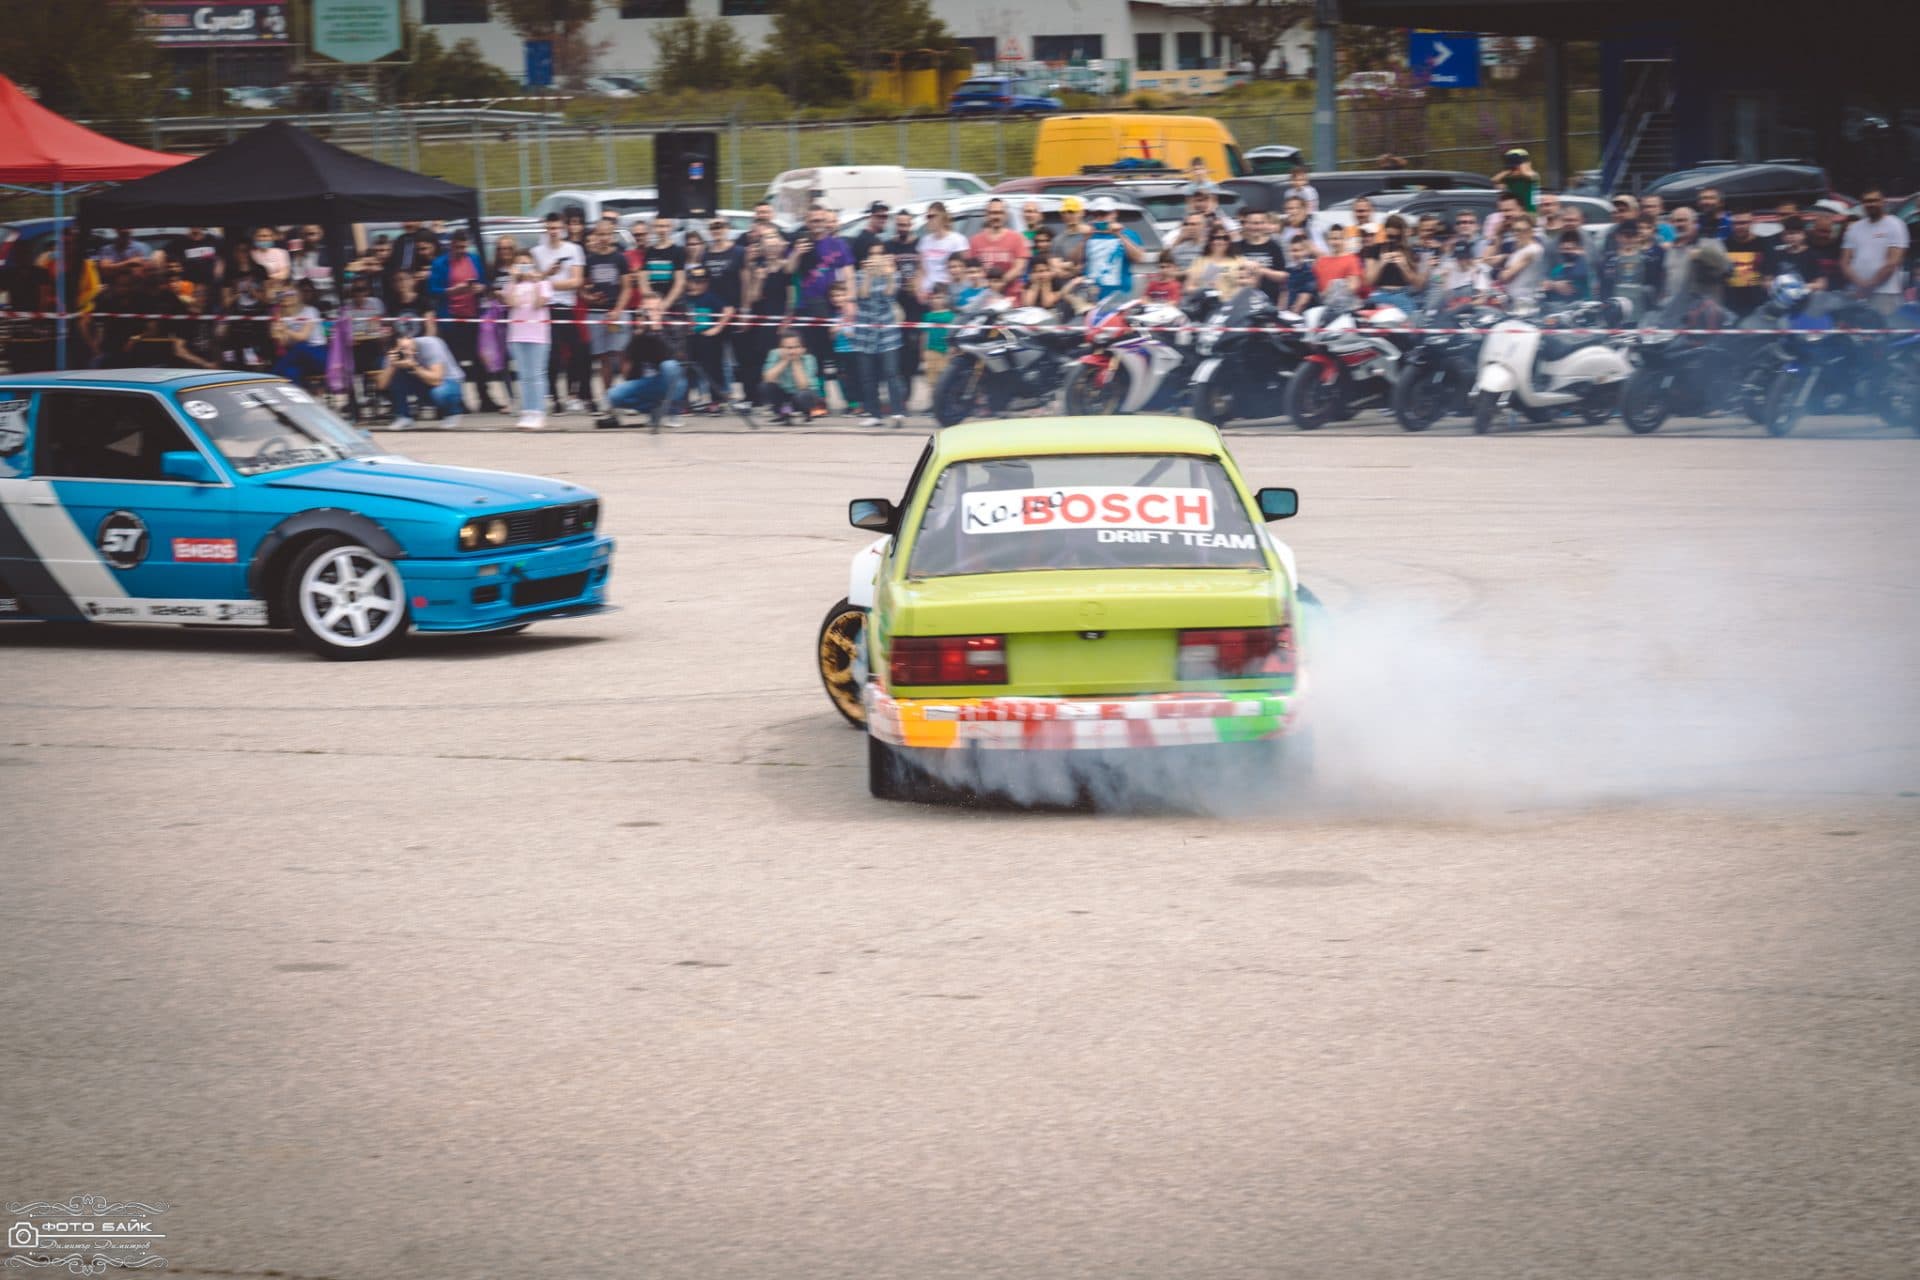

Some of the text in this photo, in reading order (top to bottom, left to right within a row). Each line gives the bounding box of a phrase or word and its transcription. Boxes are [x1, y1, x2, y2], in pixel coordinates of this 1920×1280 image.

[1022, 493, 1210, 526] BOSCH
[102, 528, 144, 552] 57
[1097, 530, 1256, 549] DRIFT TEAM
